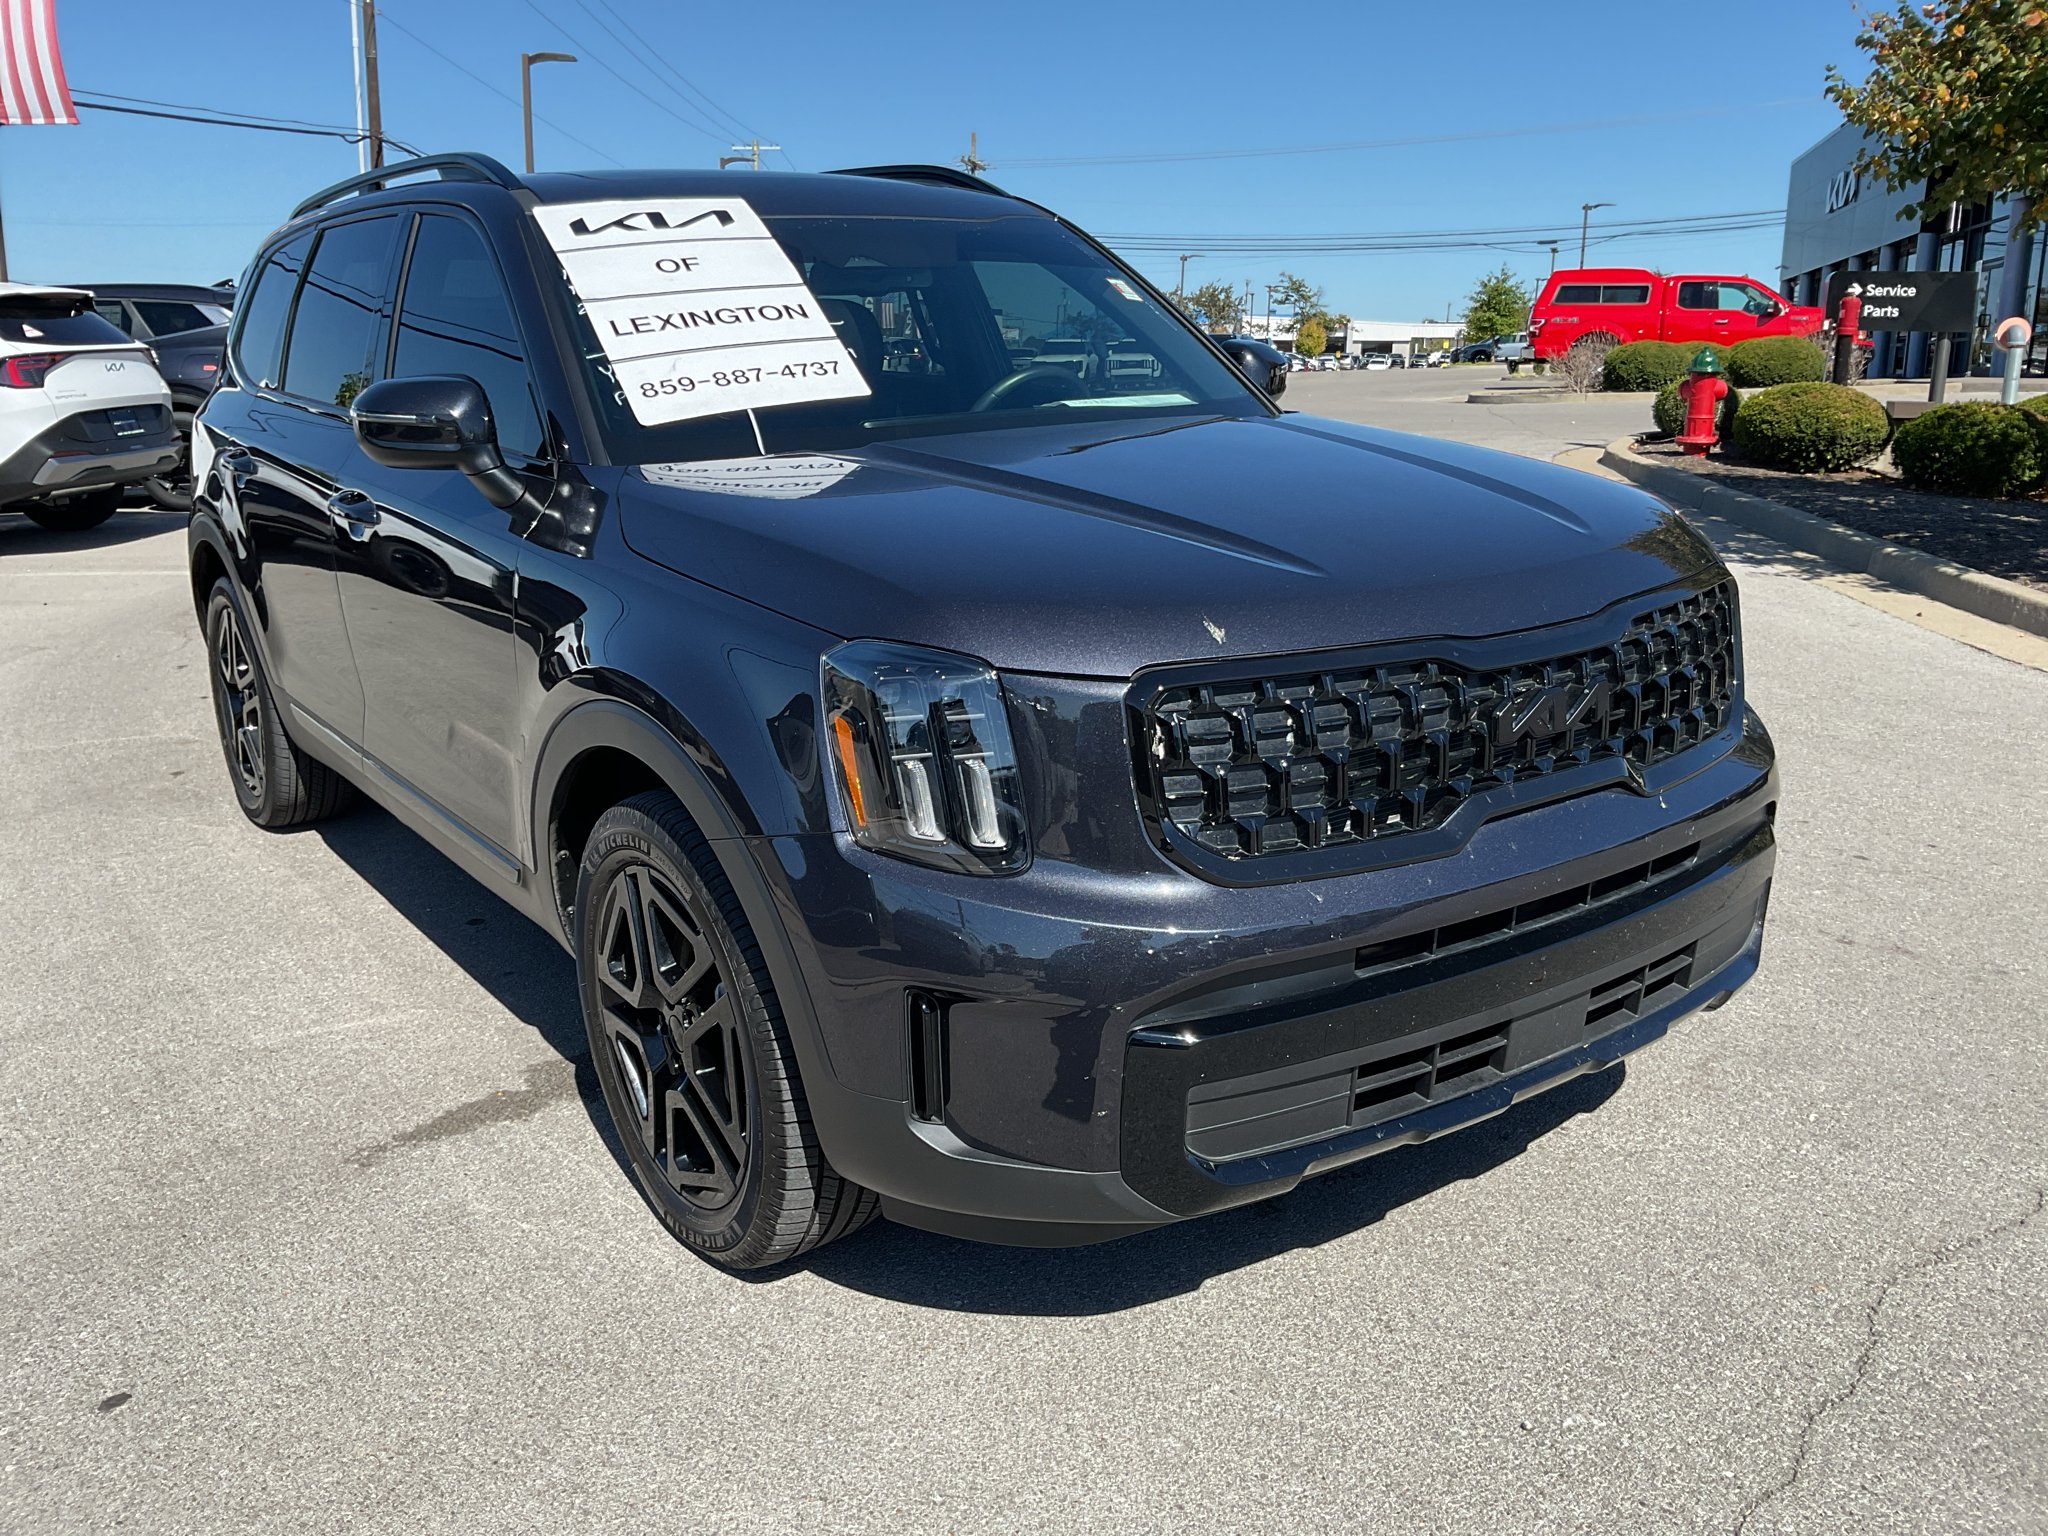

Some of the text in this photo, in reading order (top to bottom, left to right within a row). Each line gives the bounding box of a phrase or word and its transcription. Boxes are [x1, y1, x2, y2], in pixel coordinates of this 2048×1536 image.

[1825, 169, 1859, 213] KIA
[569, 210, 735, 236] KIA
[655, 257, 700, 273] OF
[1866, 284, 1917, 297] Service
[608, 303, 809, 337] LEXINGTON
[1863, 304, 1900, 317] Parts
[105, 362, 125, 372] KIA
[640, 360, 840, 398] 859-887-4737
[1492, 675, 1611, 743] KIA
[598, 833, 649, 854] MICHELIN
[665, 1212, 725, 1248] MICHELIN
